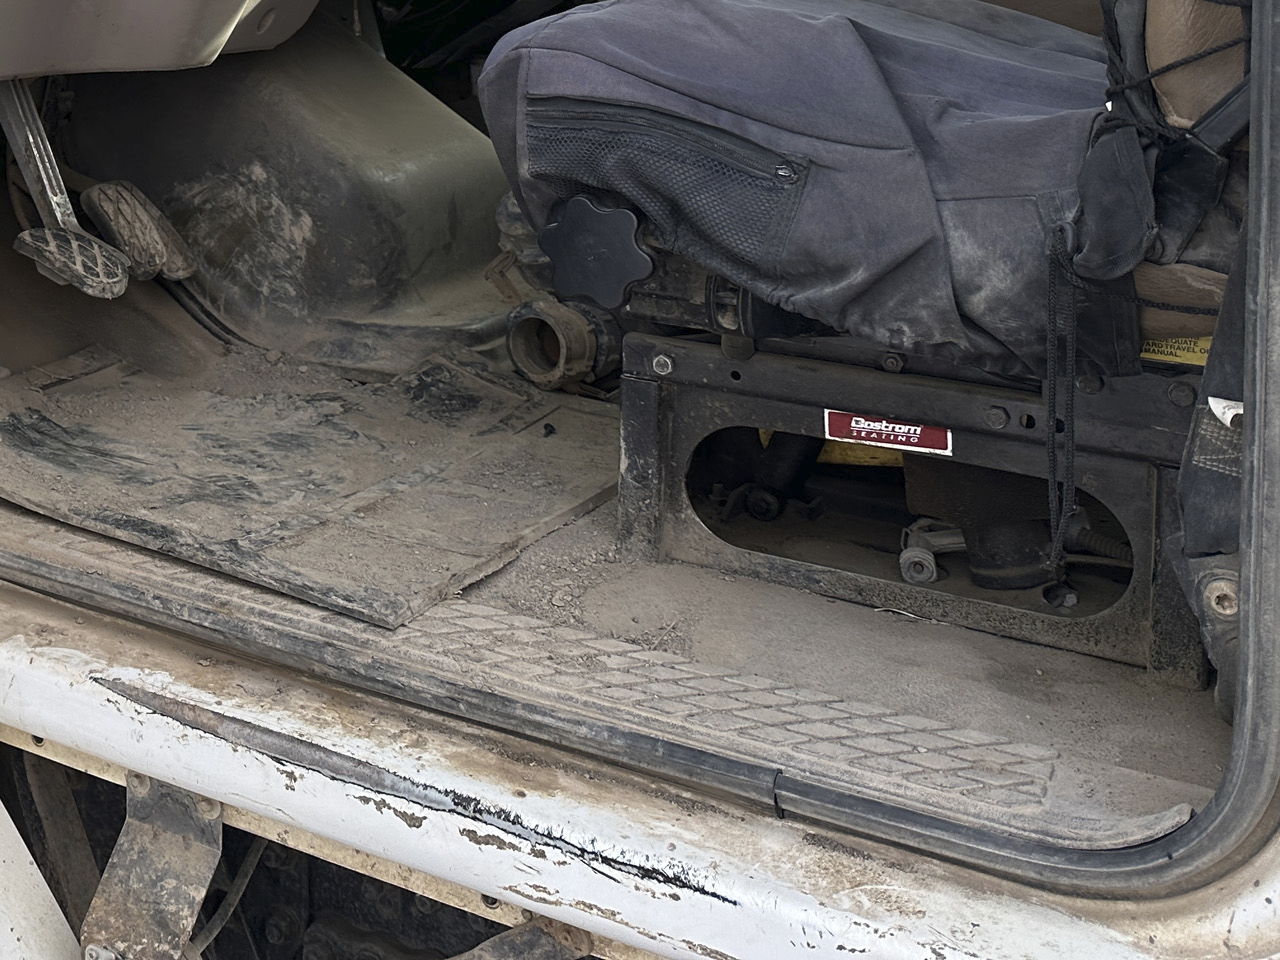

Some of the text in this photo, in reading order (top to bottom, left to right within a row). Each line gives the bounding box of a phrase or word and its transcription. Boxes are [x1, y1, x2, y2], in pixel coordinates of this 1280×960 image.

[1165, 344, 1198, 354] TRAVEL
[850, 417, 922, 435] Bostrom
[851, 431, 919, 443] SEATING
